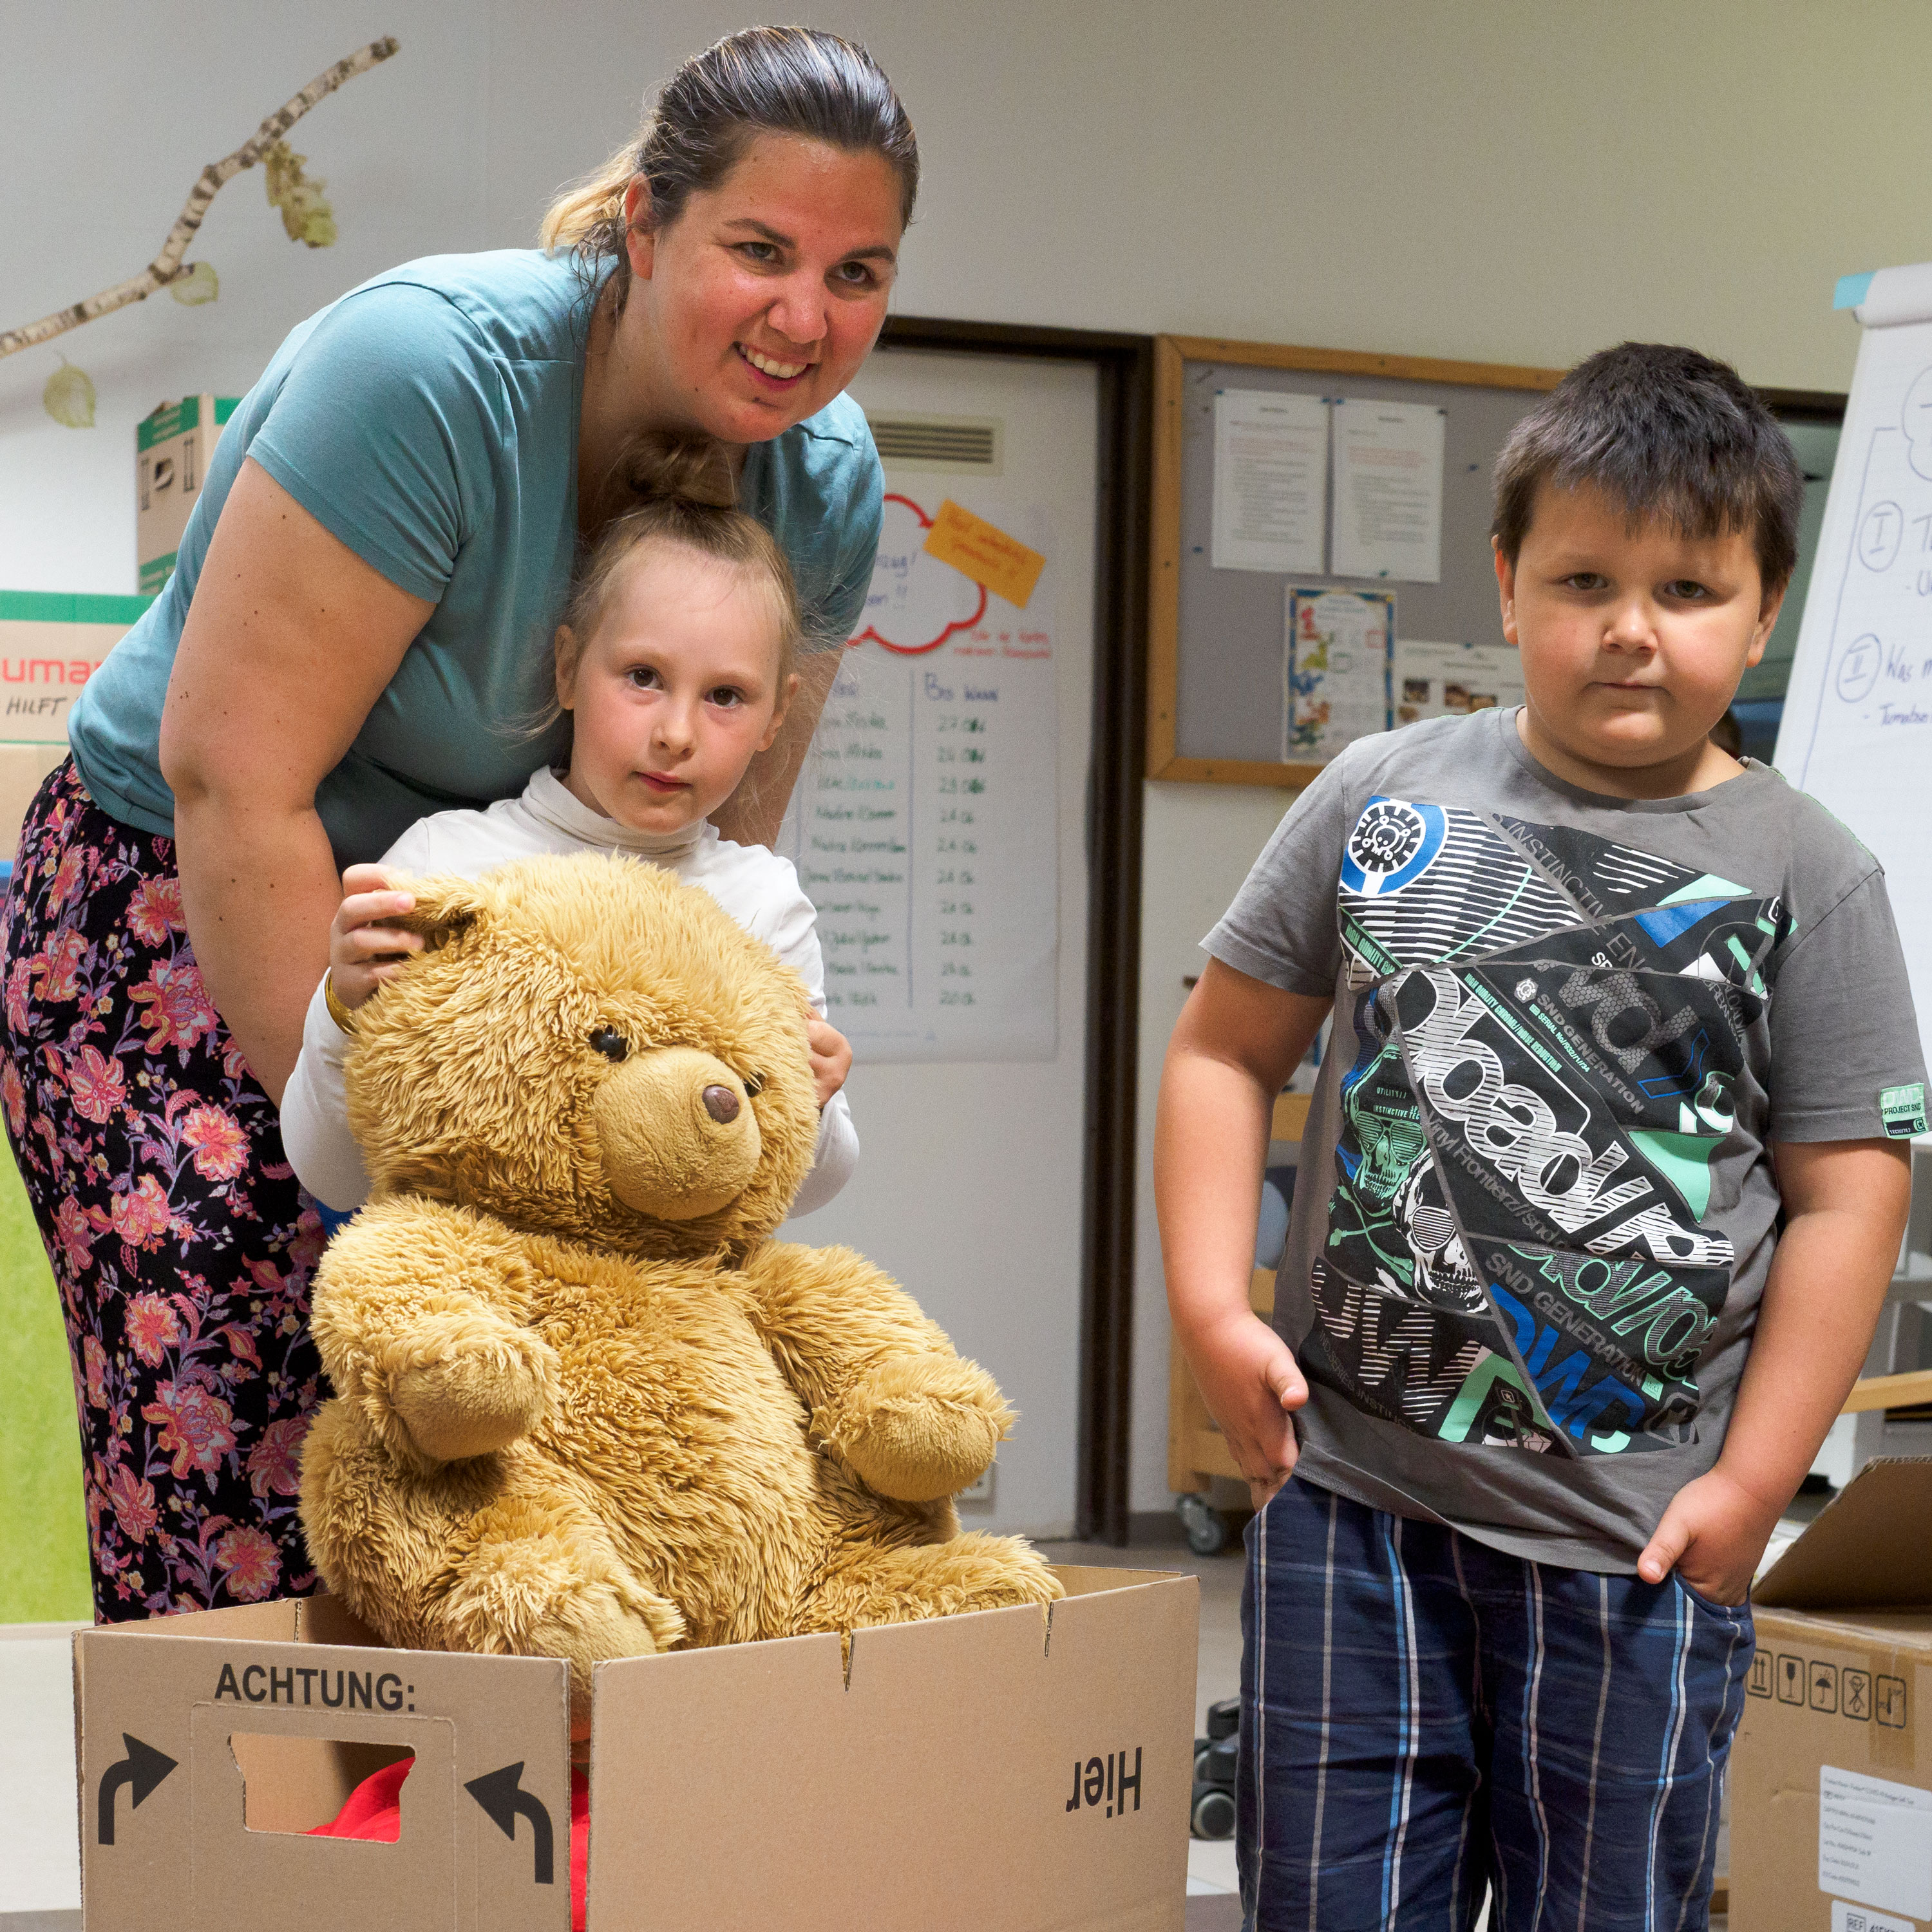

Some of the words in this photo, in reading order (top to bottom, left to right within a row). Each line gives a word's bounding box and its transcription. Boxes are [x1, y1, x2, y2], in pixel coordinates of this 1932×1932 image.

[2, 658, 103, 685] uma
[6, 696, 68, 716] HILFT
[1537, 994, 1566, 1026] SND
[1563, 1024, 1645, 1115] GENERATION
[1373, 1104, 1408, 1119] INSTINCTIVE
[1884, 1104, 1911, 1115] PROJECT
[1484, 1253, 1535, 1295] SND
[1533, 1291, 1646, 1387] GENERATION
[214, 1663, 416, 1712] ACHTUNG:
[1065, 1746, 1142, 1819] Hier
